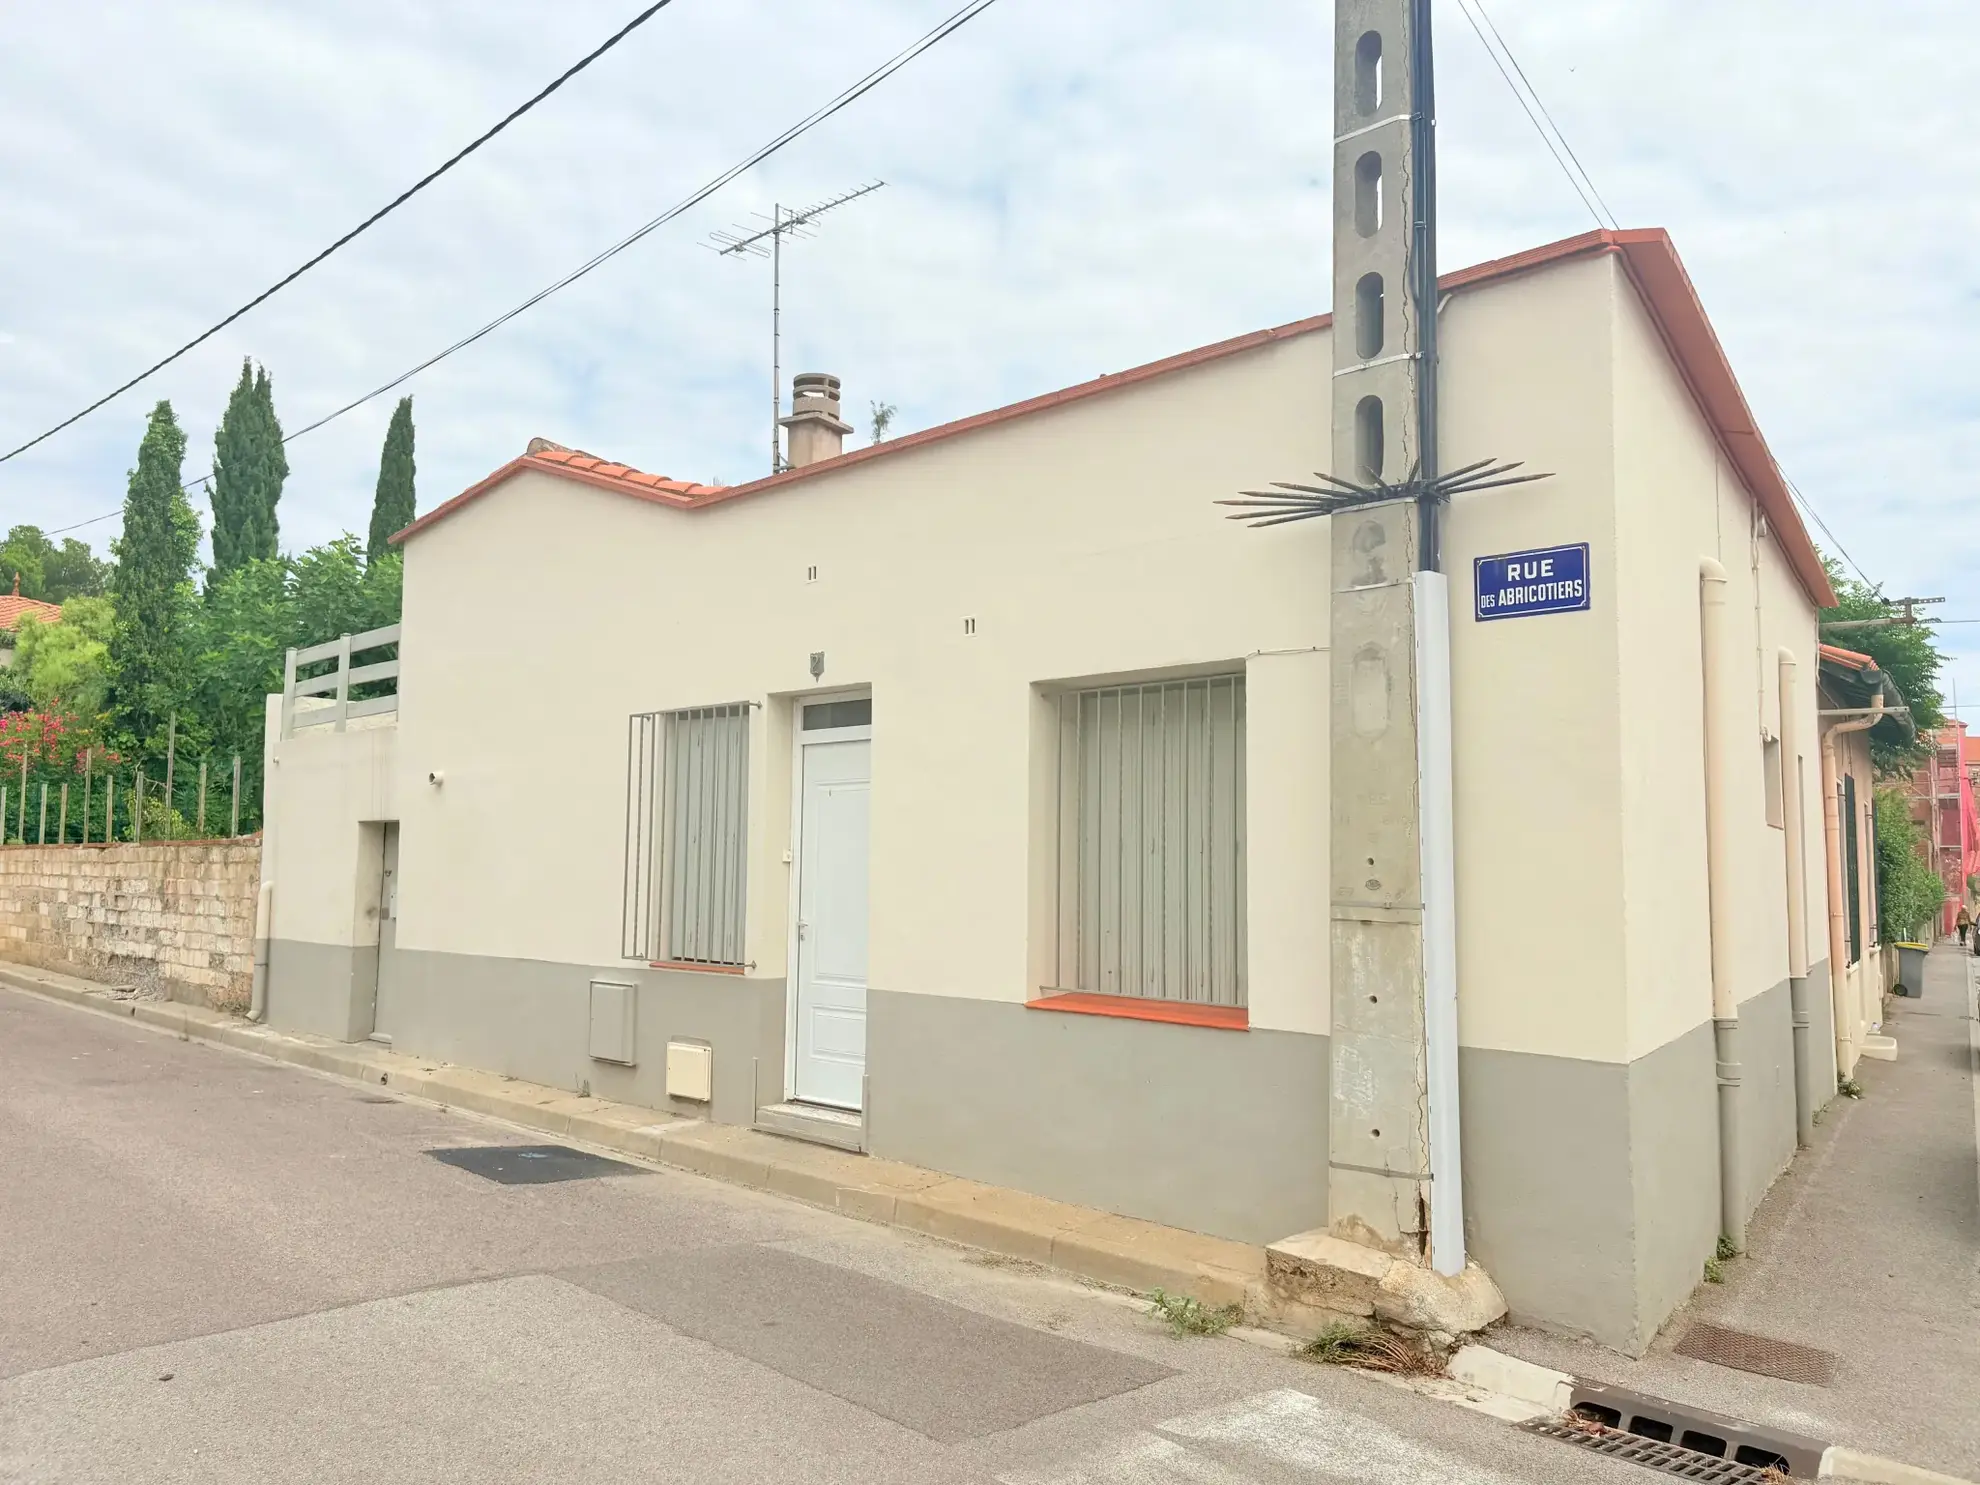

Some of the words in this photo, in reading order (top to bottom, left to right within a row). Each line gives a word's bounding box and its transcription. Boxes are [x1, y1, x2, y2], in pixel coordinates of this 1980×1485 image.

[1507, 559, 1554, 581] RUE
[1480, 594, 1496, 609] DES
[1498, 579, 1583, 607] ABRICOTIERS
